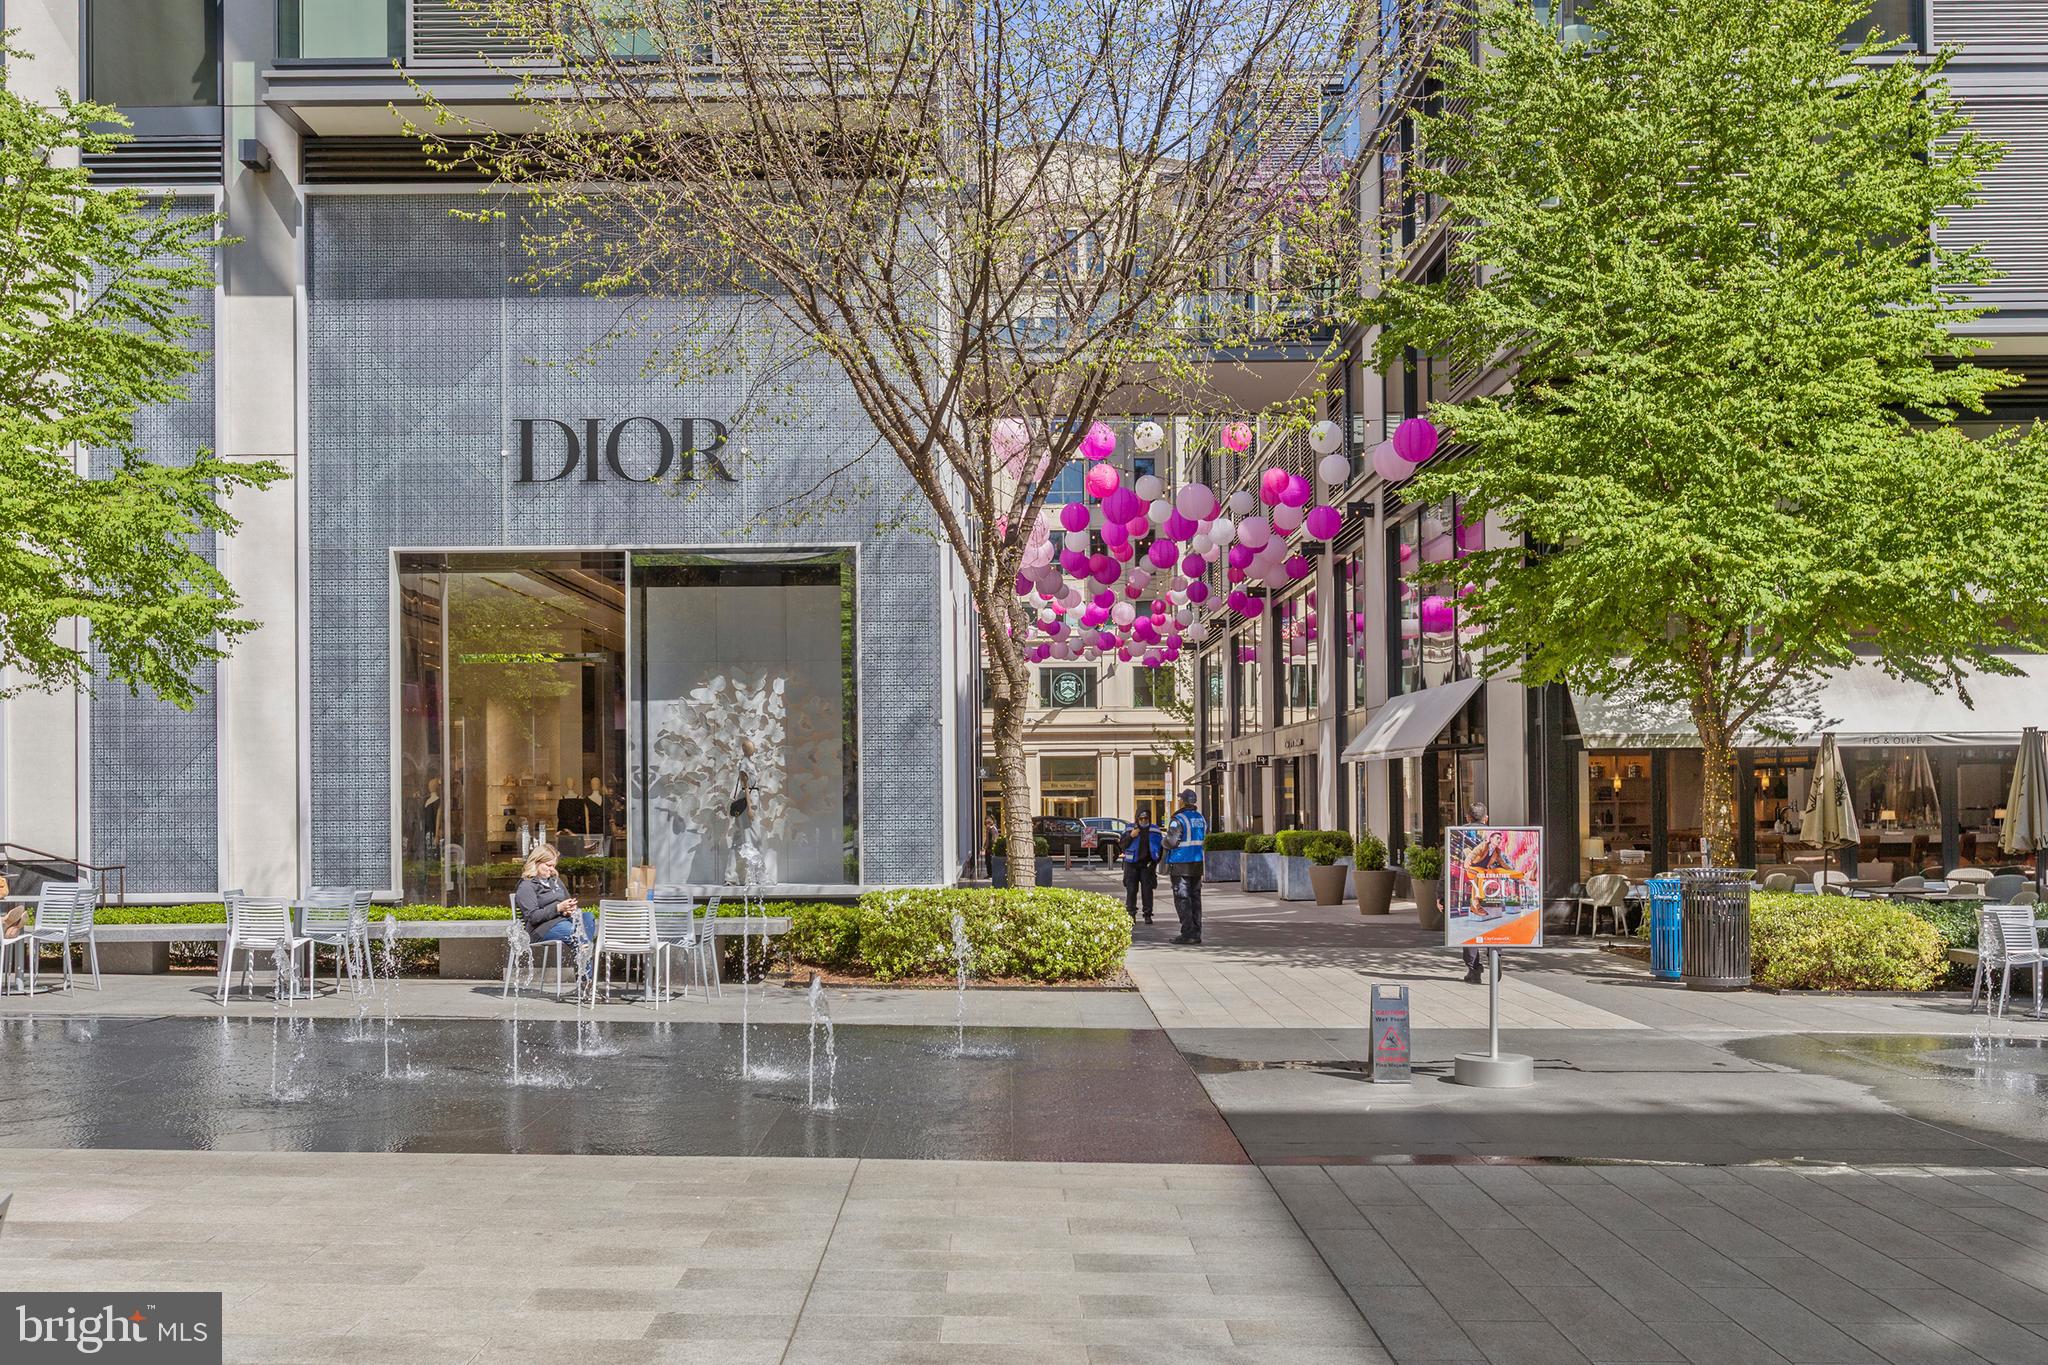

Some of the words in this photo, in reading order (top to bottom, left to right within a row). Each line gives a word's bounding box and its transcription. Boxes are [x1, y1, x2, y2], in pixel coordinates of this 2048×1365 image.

[513, 416, 739, 483] DIOR
[1863, 736, 1880, 745] FIG
[1883, 736, 1890, 745] &
[1893, 736, 1922, 745] OLIVE
